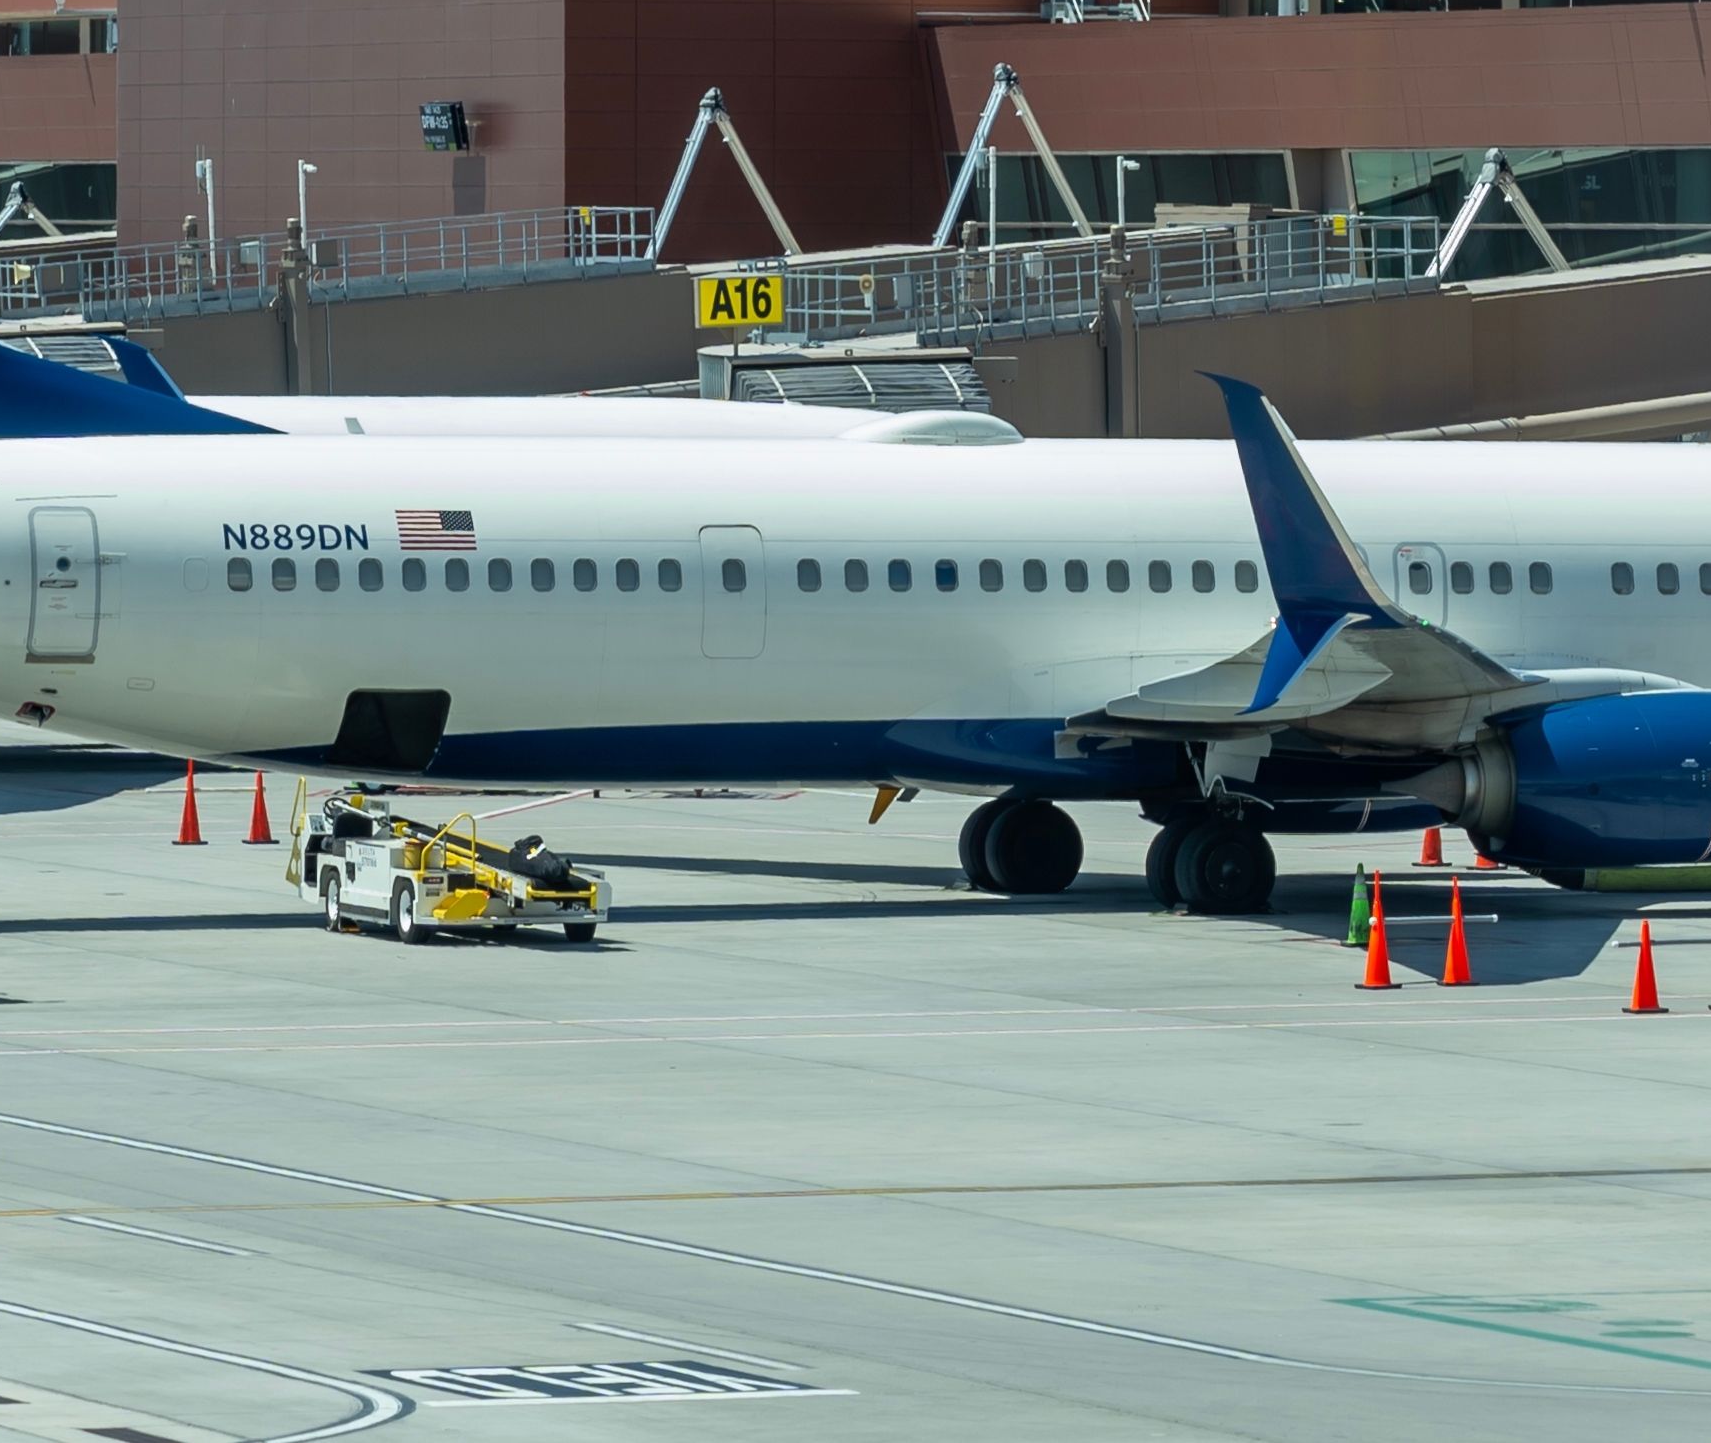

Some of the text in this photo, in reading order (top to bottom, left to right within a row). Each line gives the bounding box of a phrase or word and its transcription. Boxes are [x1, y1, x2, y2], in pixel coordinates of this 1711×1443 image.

[710, 277, 772, 320] A16
[222, 523, 369, 550] N889DN
[390, 1362, 801, 1398] YIELD
